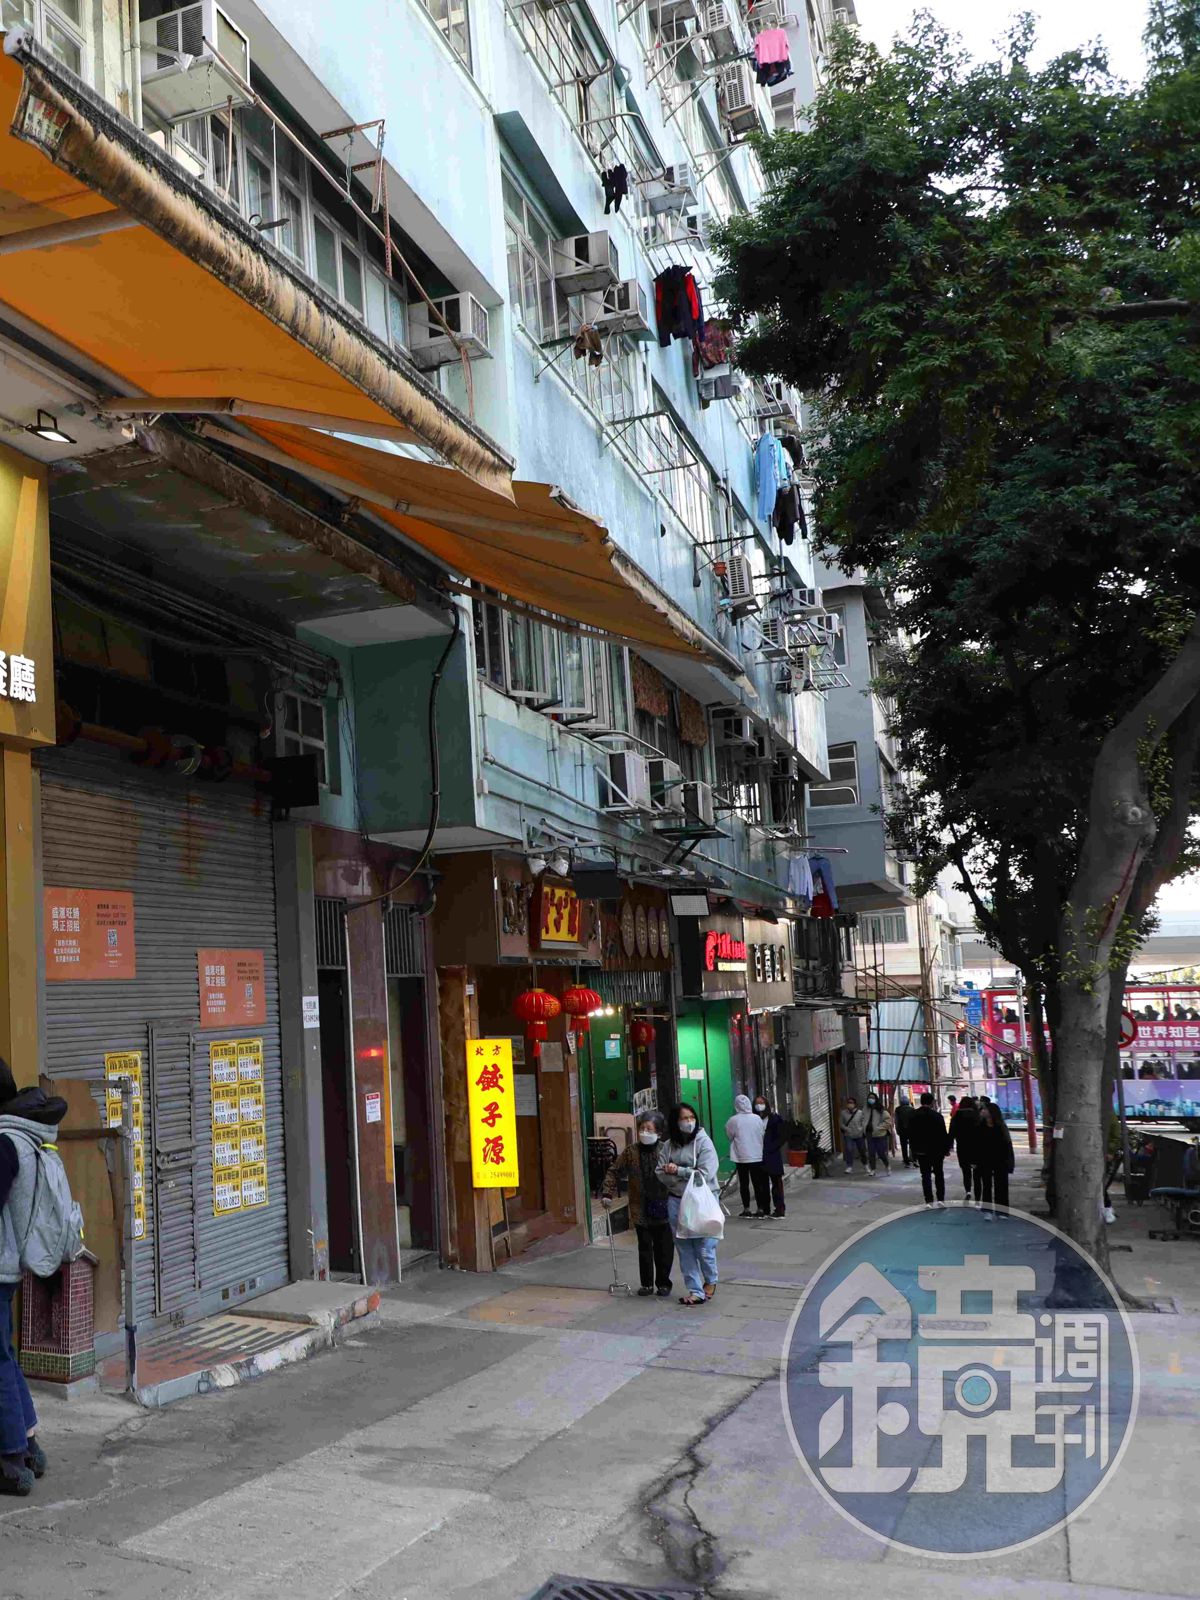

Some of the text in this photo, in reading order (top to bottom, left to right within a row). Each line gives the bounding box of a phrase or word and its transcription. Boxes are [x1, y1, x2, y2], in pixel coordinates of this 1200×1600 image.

[1137, 1025, 1200, 1038] 世界知名
[475, 1045, 501, 1056] 北方
[476, 1063, 505, 1165] 餃子源
